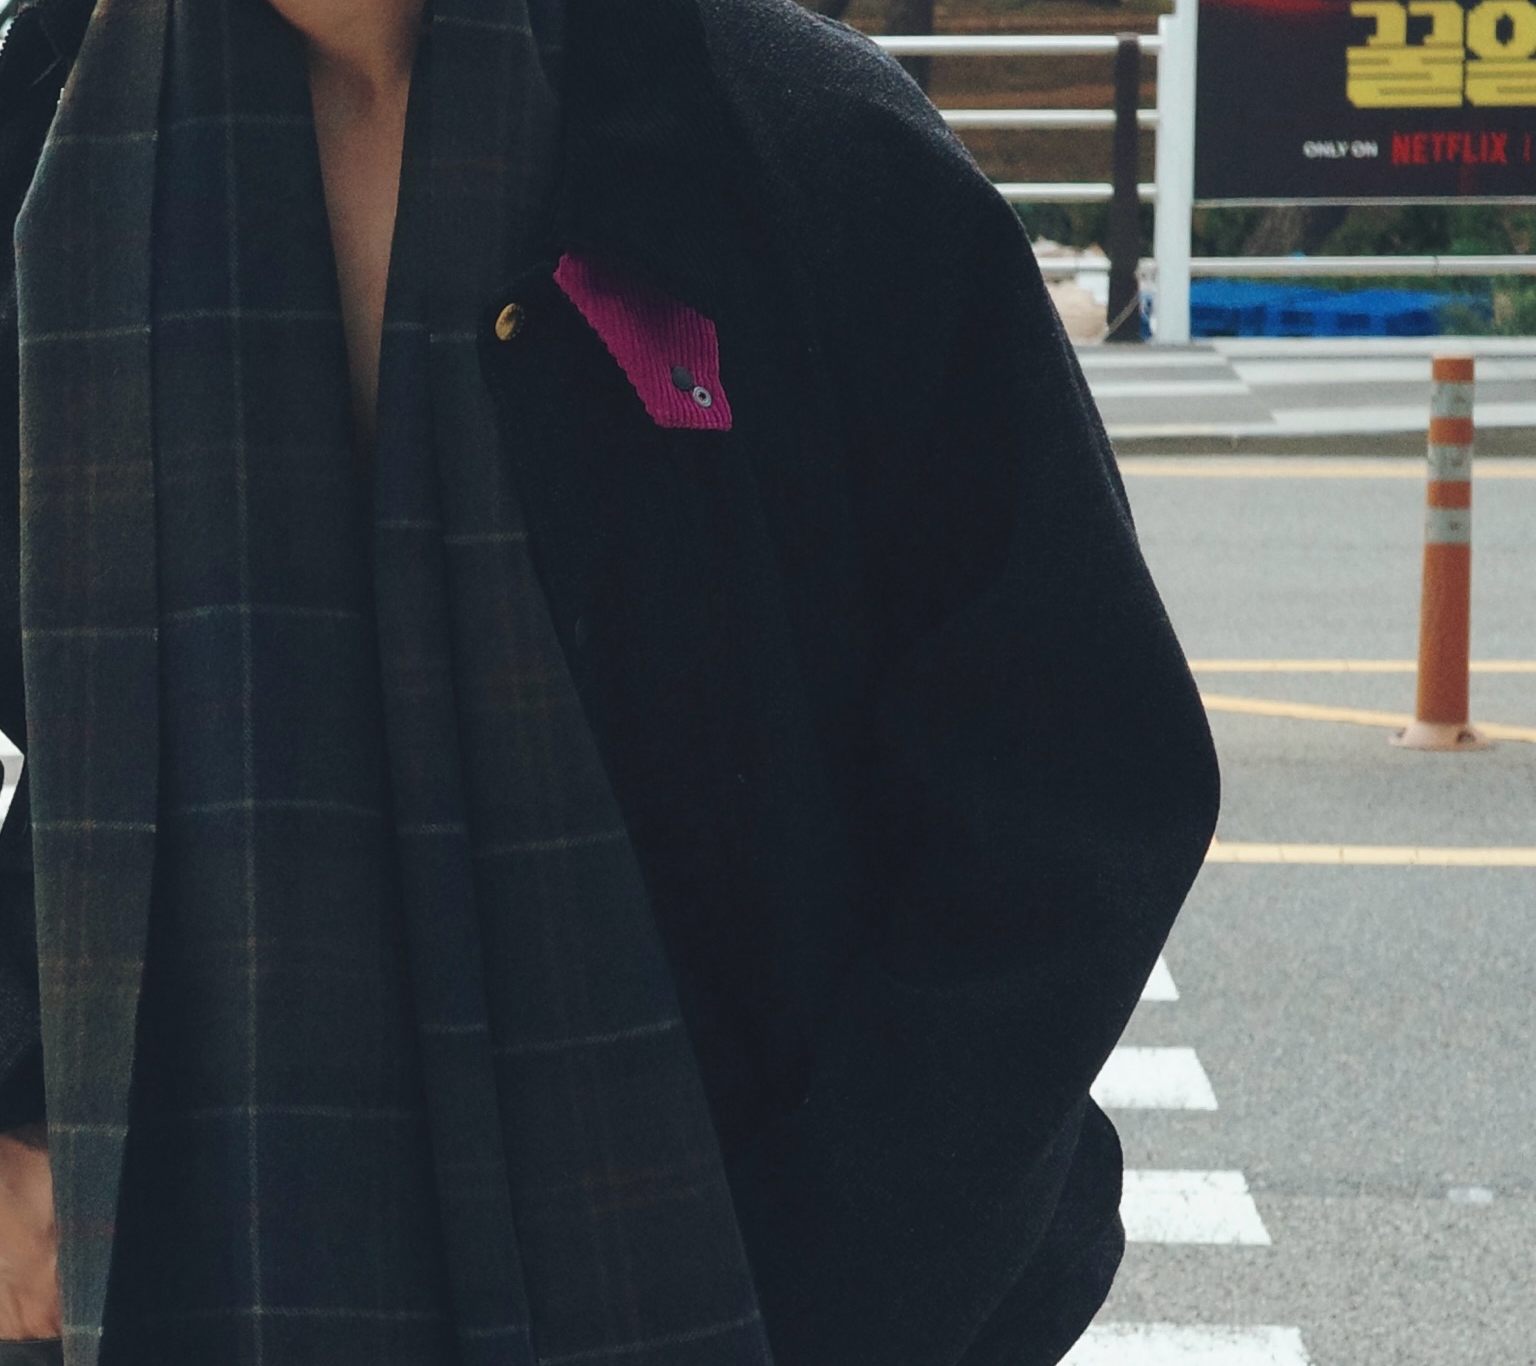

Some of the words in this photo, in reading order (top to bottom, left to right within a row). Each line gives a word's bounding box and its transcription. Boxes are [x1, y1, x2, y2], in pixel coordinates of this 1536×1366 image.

[1302, 140, 1350, 159] ONLY
[1351, 140, 1379, 158] ON
[1391, 132, 1508, 165] NETFLIX
